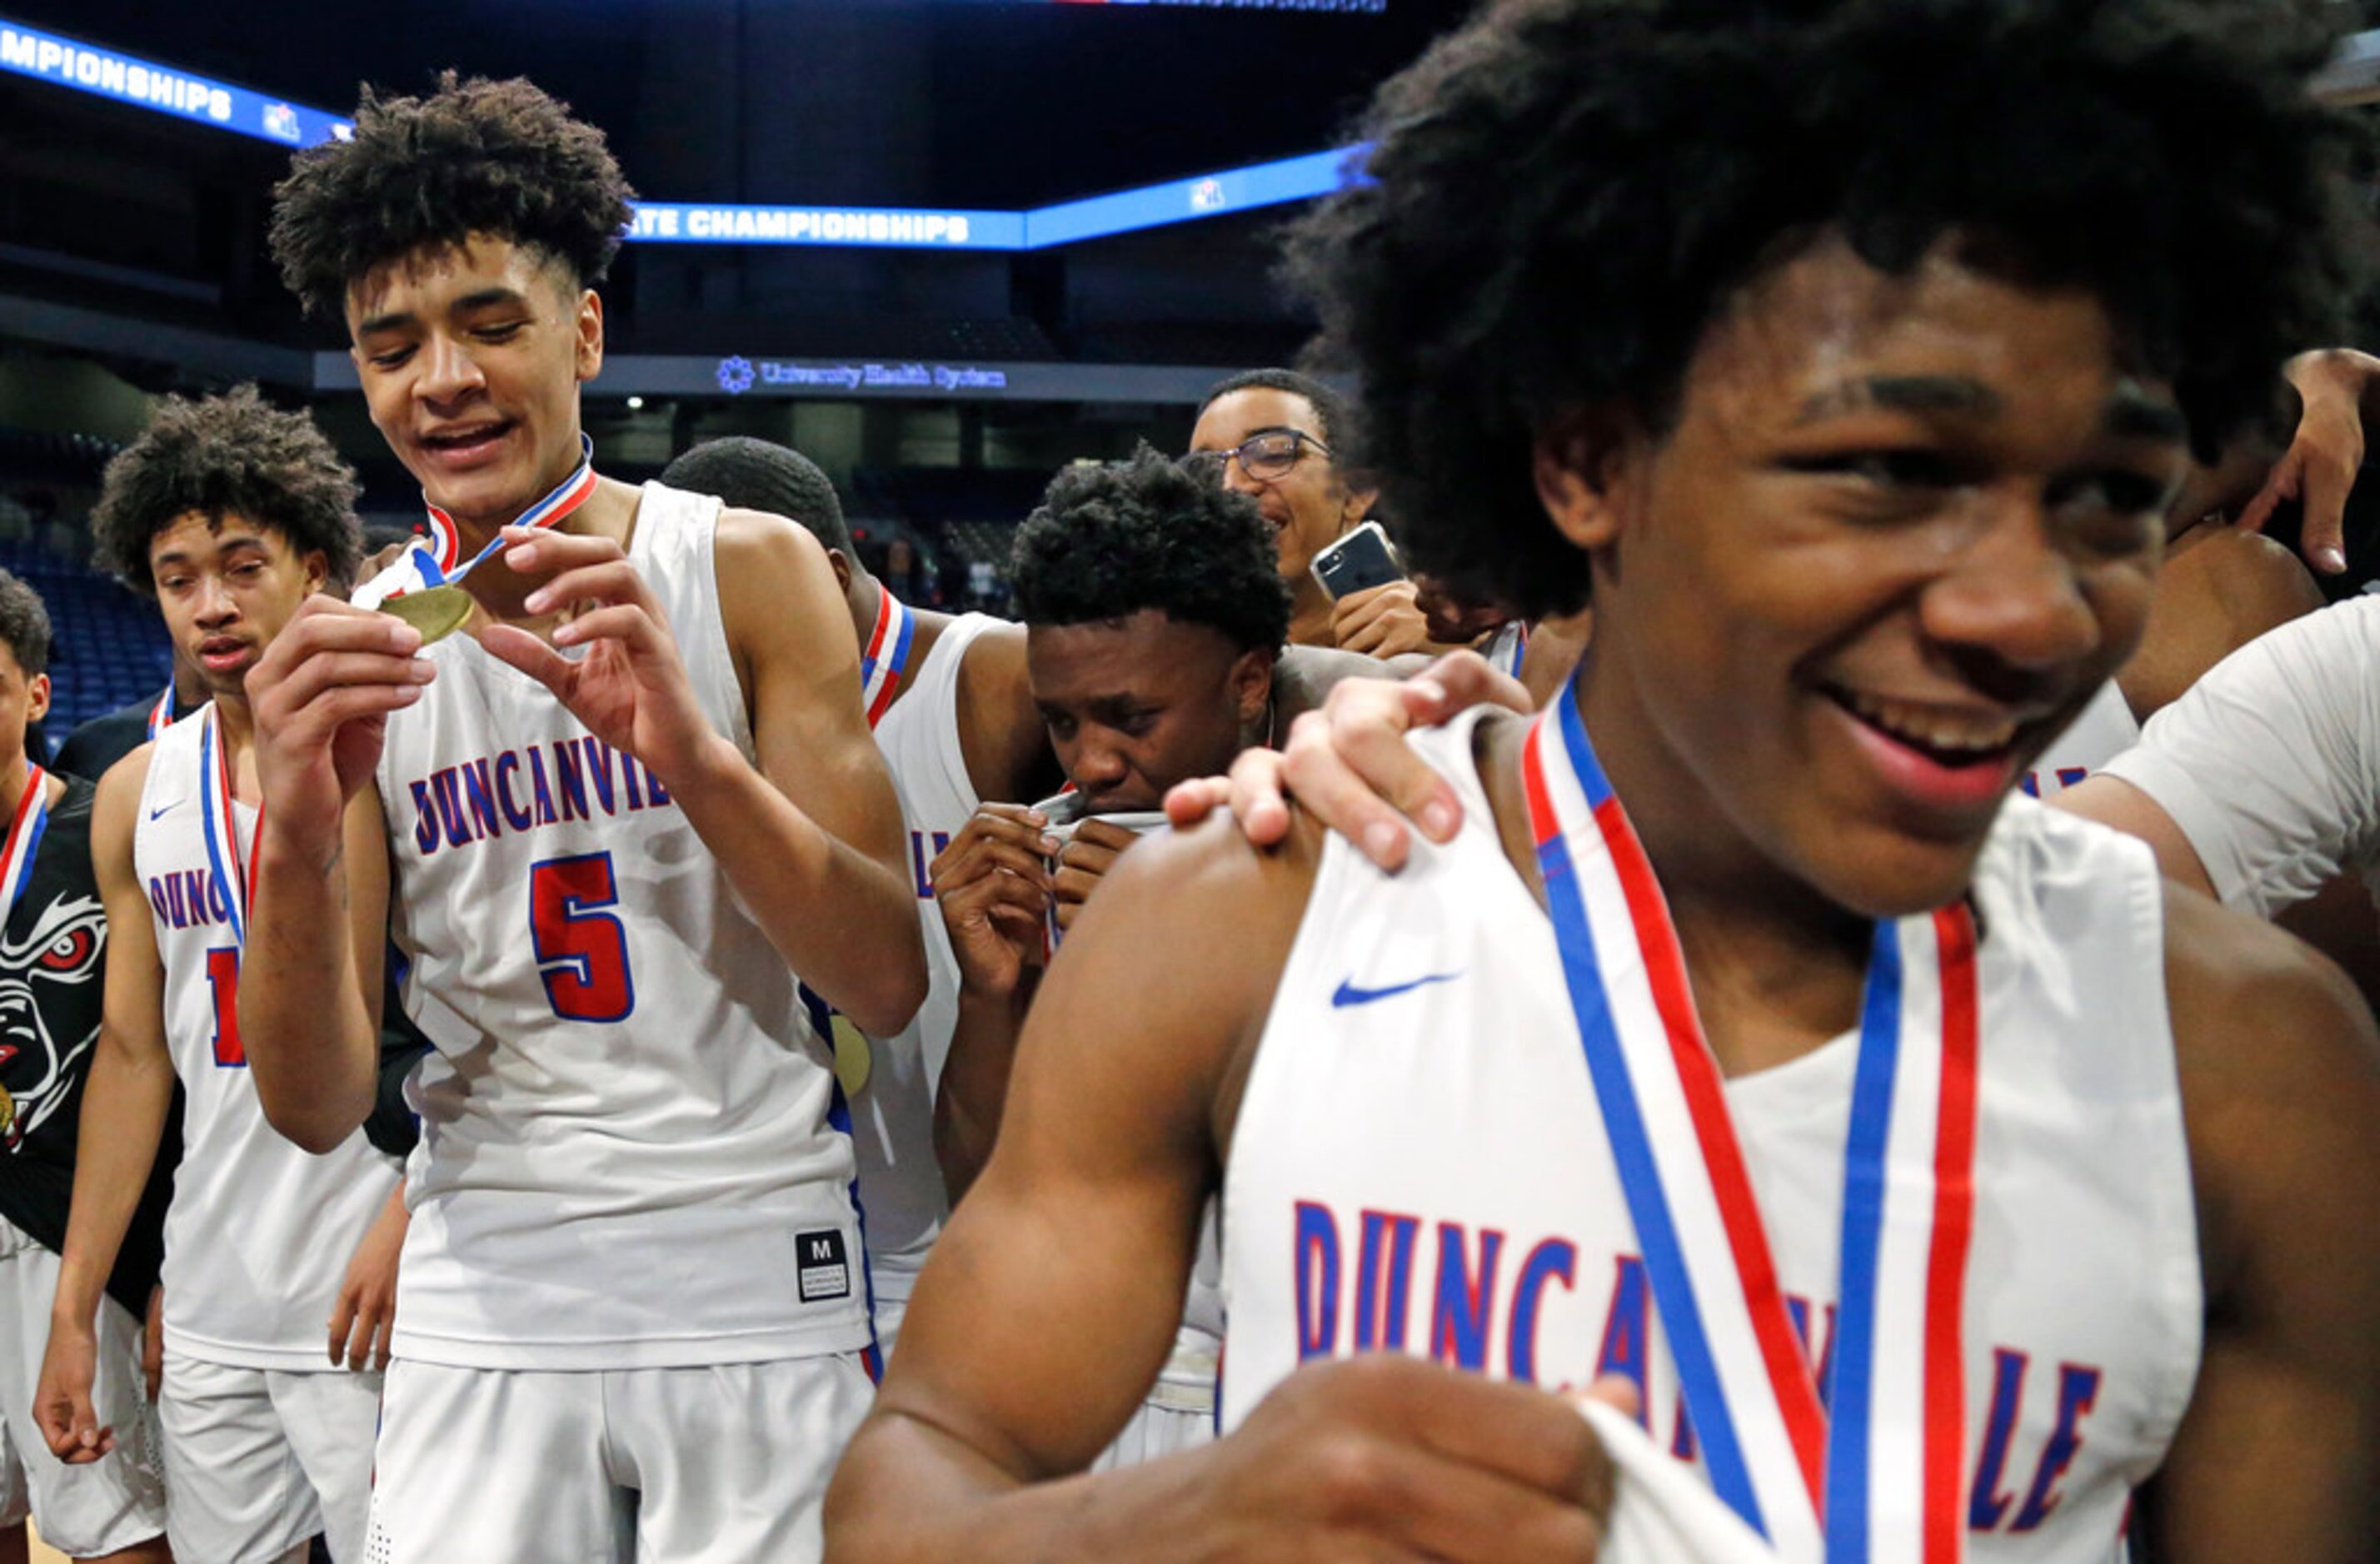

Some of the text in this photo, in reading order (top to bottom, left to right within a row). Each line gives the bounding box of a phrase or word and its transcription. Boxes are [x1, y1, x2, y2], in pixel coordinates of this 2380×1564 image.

[1, 29, 232, 122] MPIONSHIPS
[686, 210, 969, 243] CHAMPIONSHIPS
[530, 849, 635, 1024] 5
[207, 946, 247, 1067] 1
[811, 1239, 832, 1261] M
